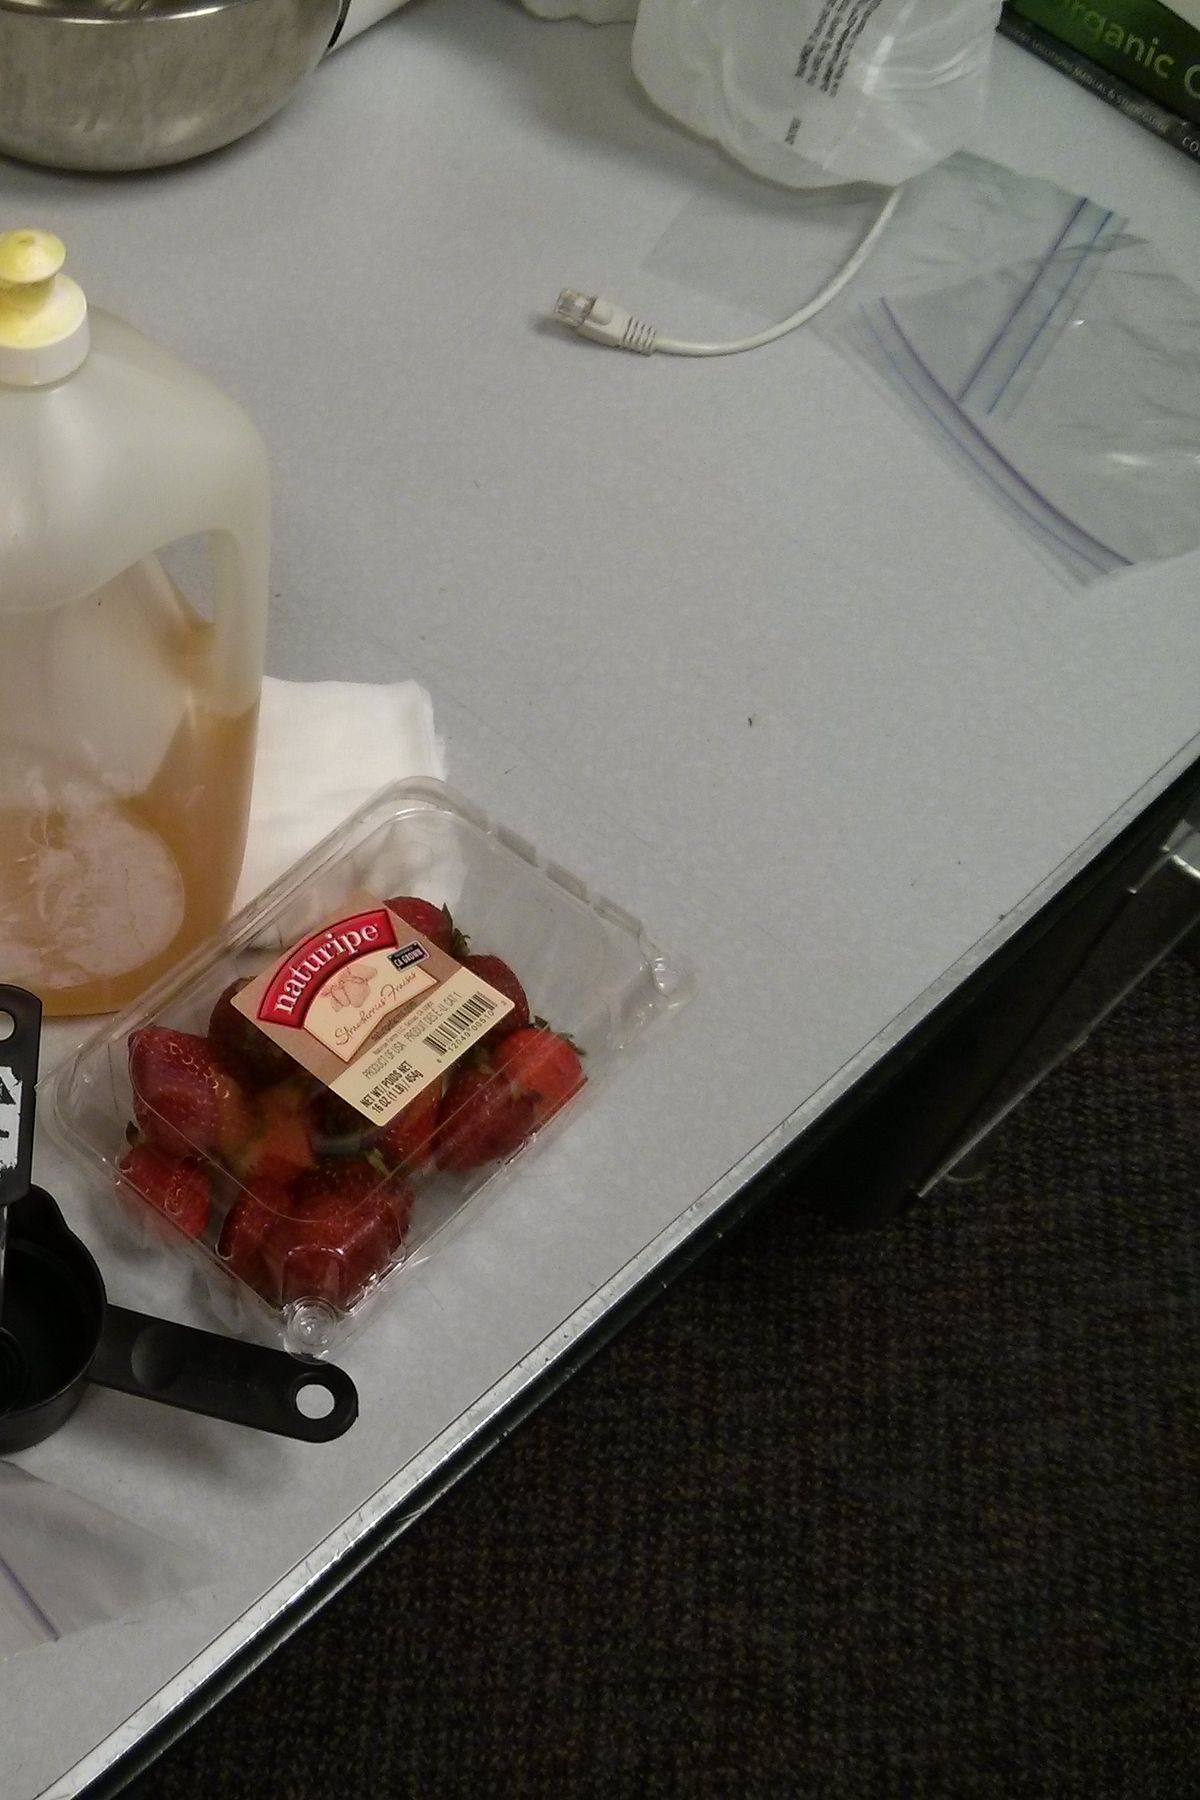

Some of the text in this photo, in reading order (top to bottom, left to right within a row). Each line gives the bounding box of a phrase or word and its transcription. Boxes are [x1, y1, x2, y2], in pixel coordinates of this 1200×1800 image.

[274, 923, 380, 1015] naturipe
[359, 1092, 375, 1108] NET
[380, 1068, 402, 1089] POIDS
[396, 1059, 412, 1075] NET
[370, 1102, 383, 1115] 16
[378, 1095, 391, 1108] OZ
[404, 1067, 423, 1086] 454g
